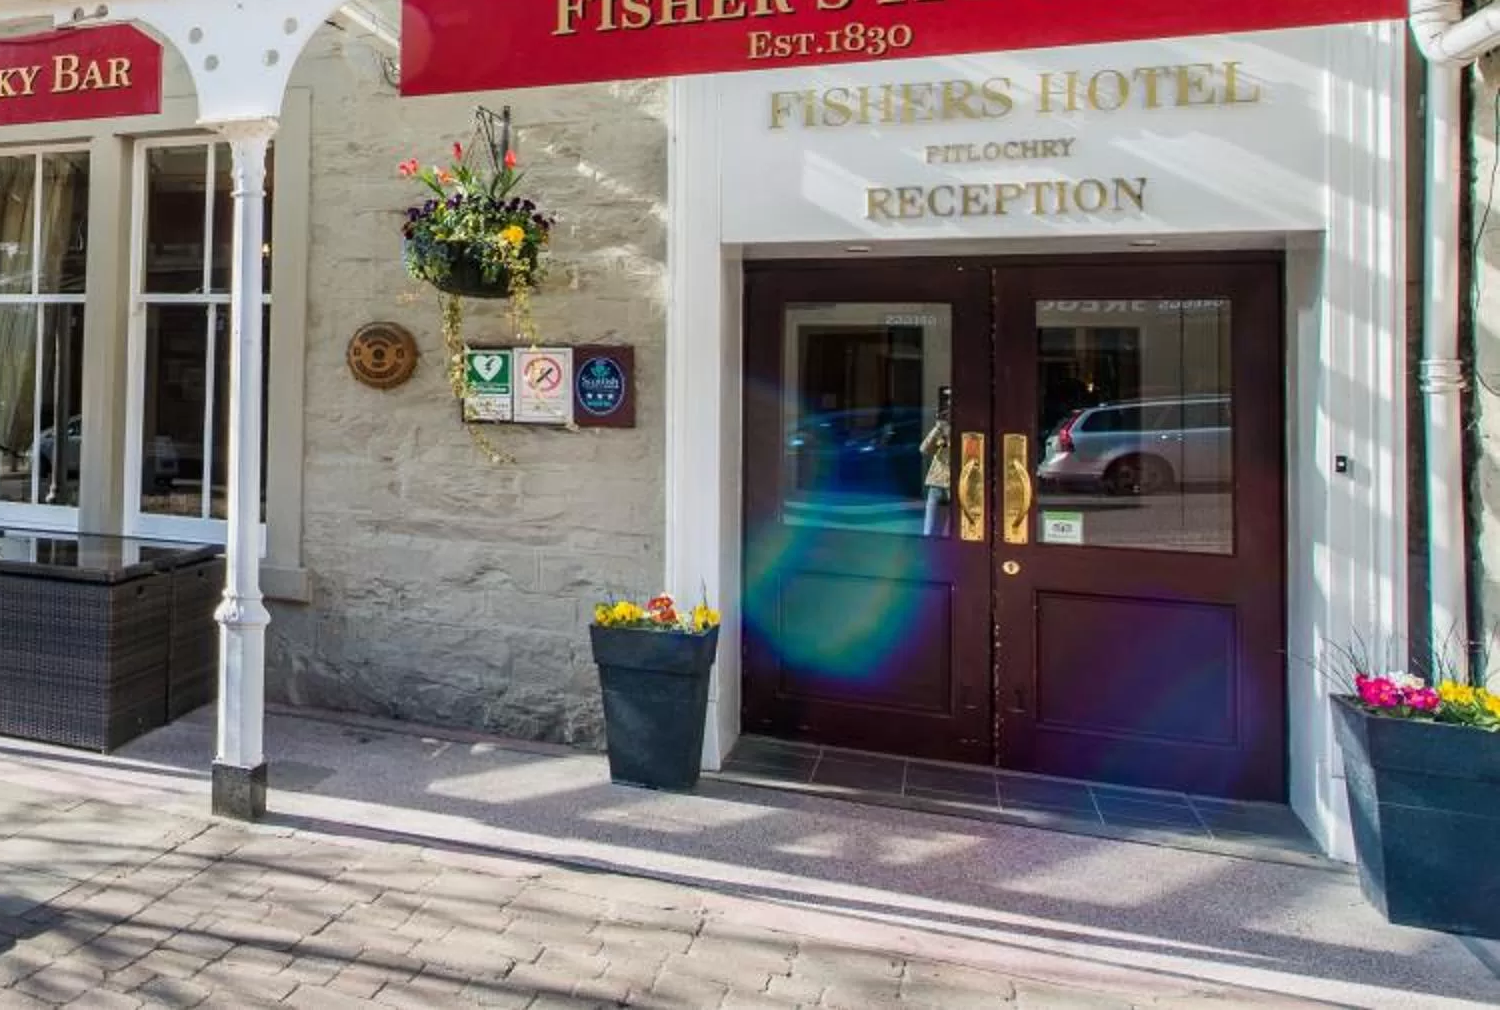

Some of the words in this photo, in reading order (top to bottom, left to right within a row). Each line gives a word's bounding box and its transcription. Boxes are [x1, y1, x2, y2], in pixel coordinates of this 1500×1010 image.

[50, 54, 133, 93] BAR
[767, 76, 1013, 130] FISHERS
[1036, 61, 1261, 114] HOTEL
[924, 137, 1077, 164] PITLOCHRY
[863, 176, 1149, 221] RECEPTION
